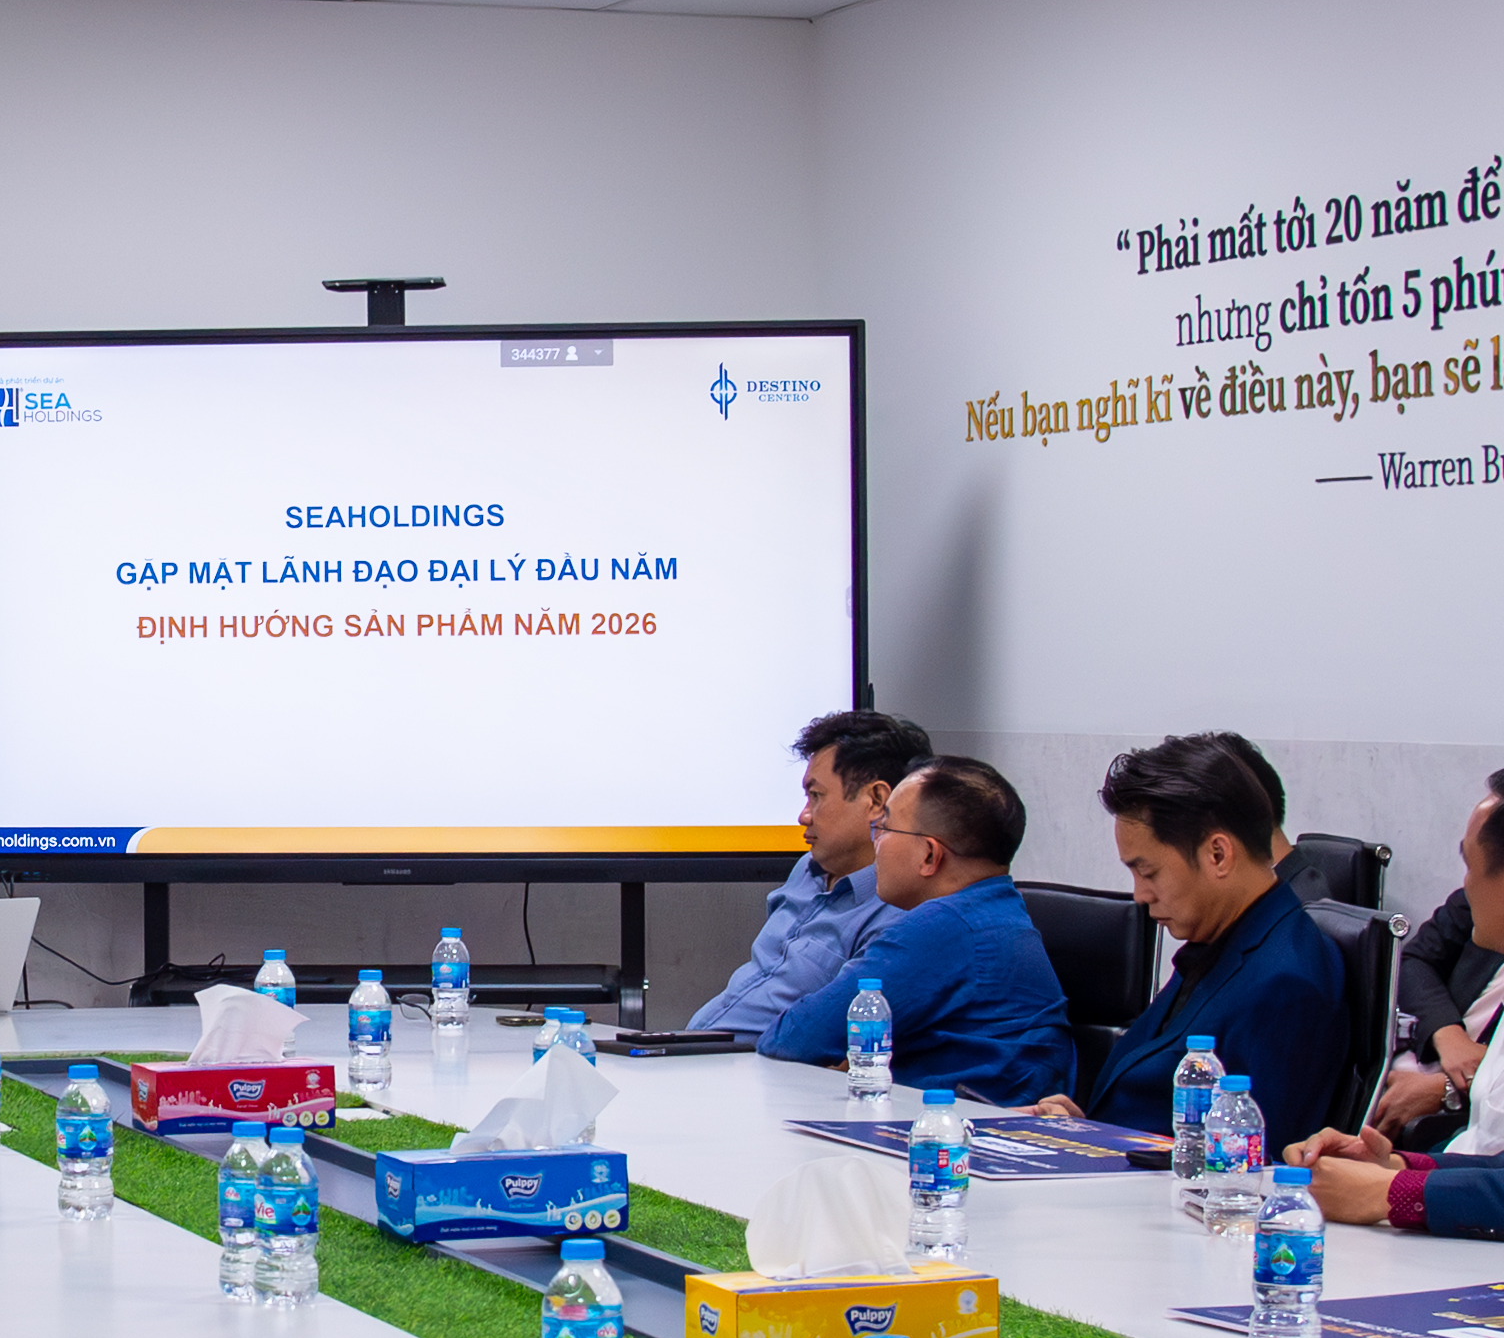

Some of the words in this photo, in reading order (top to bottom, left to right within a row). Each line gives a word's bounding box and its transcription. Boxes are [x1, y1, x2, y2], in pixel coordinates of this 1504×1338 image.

[1207, 203, 1268, 265] mất
[1274, 195, 1318, 254] tới
[1324, 194, 1363, 247] 20
[1371, 178, 1448, 239] năm
[1457, 155, 1503, 226] để
[1175, 294, 1273, 353] nhưng
[1279, 274, 1328, 335] chỉ
[1336, 266, 1394, 325] tốn
[1401, 268, 1423, 319] 5
[511, 348, 560, 361] 344377
[746, 380, 821, 392] DESTINO
[964, 389, 1016, 443] Nếu
[1021, 392, 1070, 449] bạn
[1076, 377, 1141, 443] nghĩ
[1144, 372, 1172, 427] kĩ
[1178, 363, 1213, 421] về
[1219, 360, 1286, 417] điều
[1294, 352, 1360, 422] này,
[1370, 349, 1433, 417] bạn
[1443, 336, 1481, 397] sẽ
[25, 392, 72, 410] SEA
[758, 393, 809, 402] CENTRO
[24, 410, 102, 422] HOLDINGS
[1379, 450, 1474, 492] Warren
[285, 503, 506, 530] SEAHOLDINGS
[115, 558, 179, 592] GẶP
[189, 558, 253, 591] MẶT
[262, 556, 343, 585] LÃNH
[352, 558, 420, 590] ĐẠO
[427, 559, 480, 589] ĐẠI
[490, 553, 526, 582] LÝ
[535, 552, 600, 581] ĐẦU
[611, 551, 679, 580] NĂM
[136, 615, 209, 645] ĐỊNH
[219, 609, 334, 639] HƯỚNG
[344, 608, 406, 638] SẢN
[416, 607, 504, 637] PHẨM
[513, 607, 582, 637] NĂM
[591, 612, 658, 637] 2026
[232, 1083, 261, 1093] Pulppy
[505, 1178, 539, 1190] Pulppy
[850, 1307, 892, 1325] Pulppy
